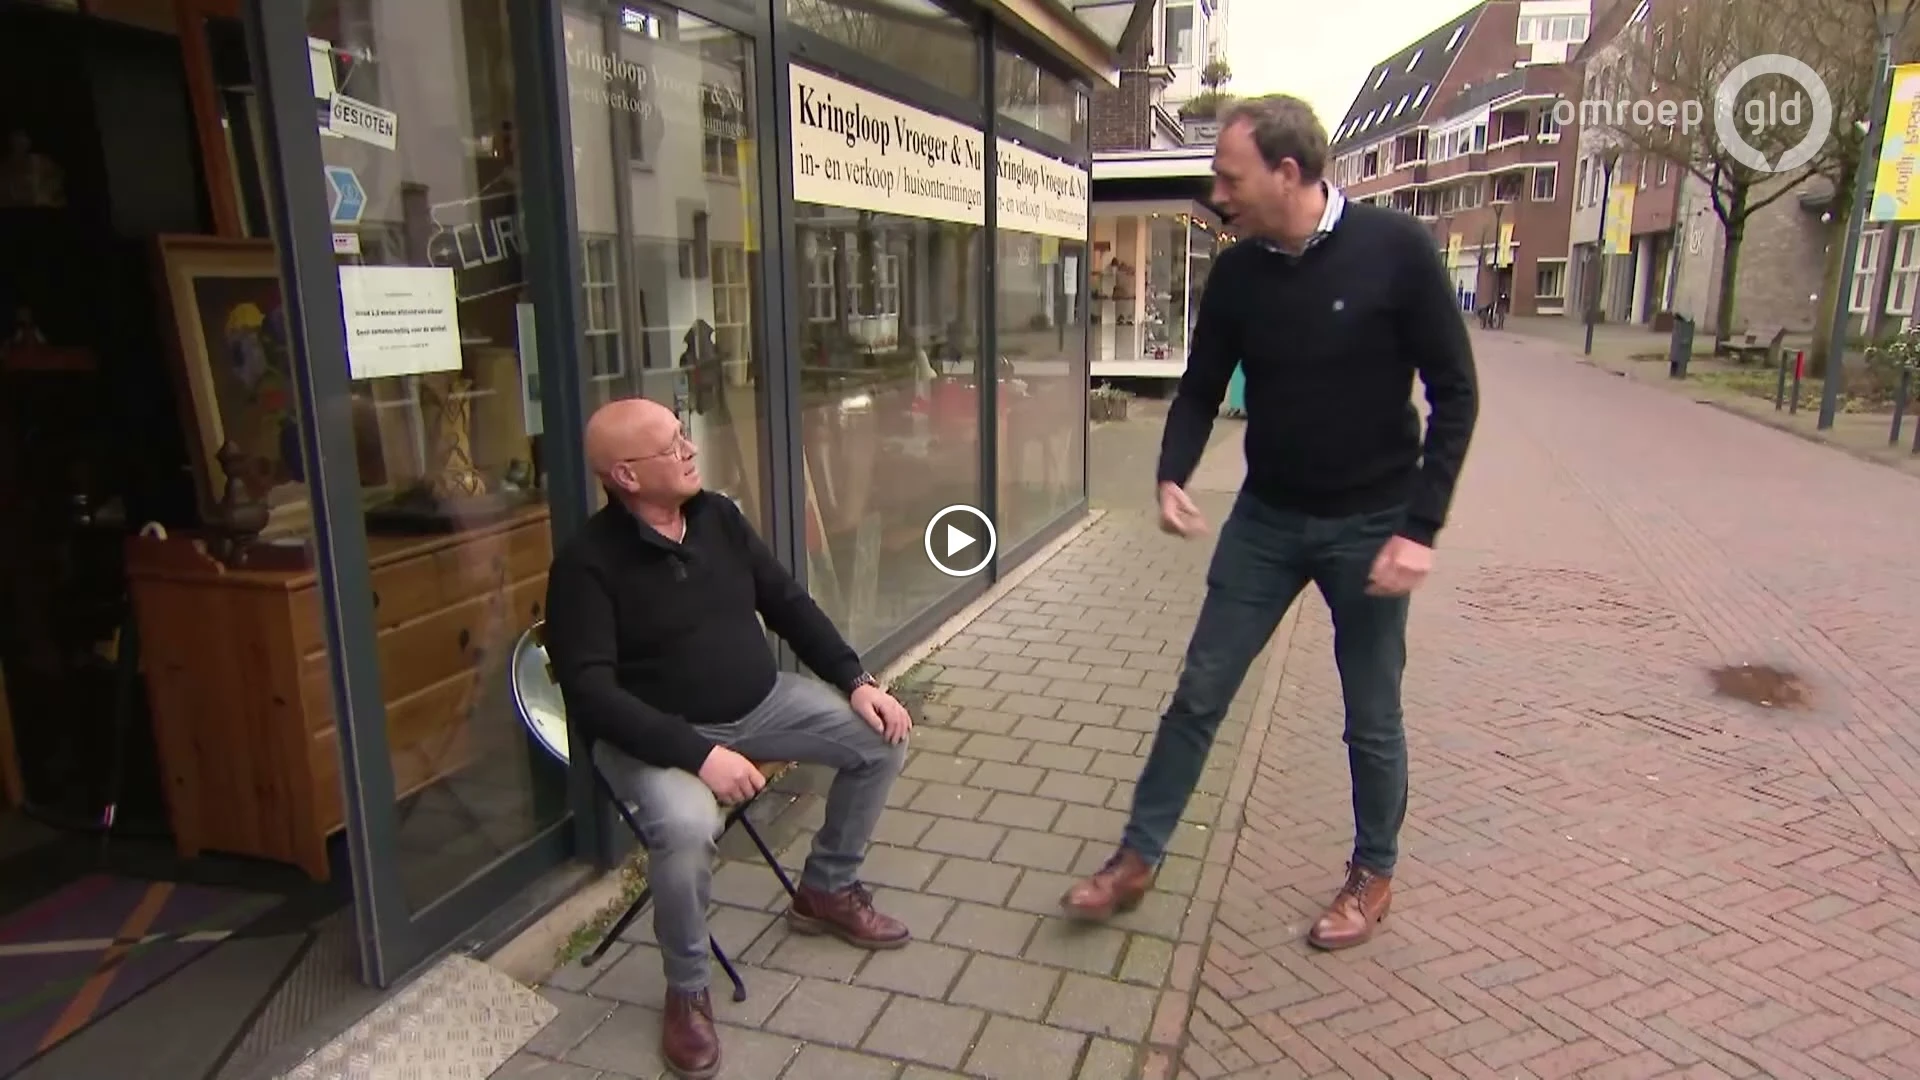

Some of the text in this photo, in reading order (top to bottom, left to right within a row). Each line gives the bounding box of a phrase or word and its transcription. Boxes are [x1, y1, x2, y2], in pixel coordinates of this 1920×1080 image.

[602, 89, 652, 121] verkoop
[711, 83, 723, 106] &
[725, 86, 744, 113] Nu
[333, 103, 393, 137] GESLOTEN
[798, 83, 981, 171] Kringloop Vroeger & Nu
[800, 141, 820, 176] in-
[825, 157, 841, 180] en
[845, 156, 894, 198] verkoop
[904, 166, 982, 210] huisontruimingen
[996, 150, 1039, 194] Kringloop
[1040, 164, 1068, 200] Vroeger
[1069, 174, 1075, 198] &
